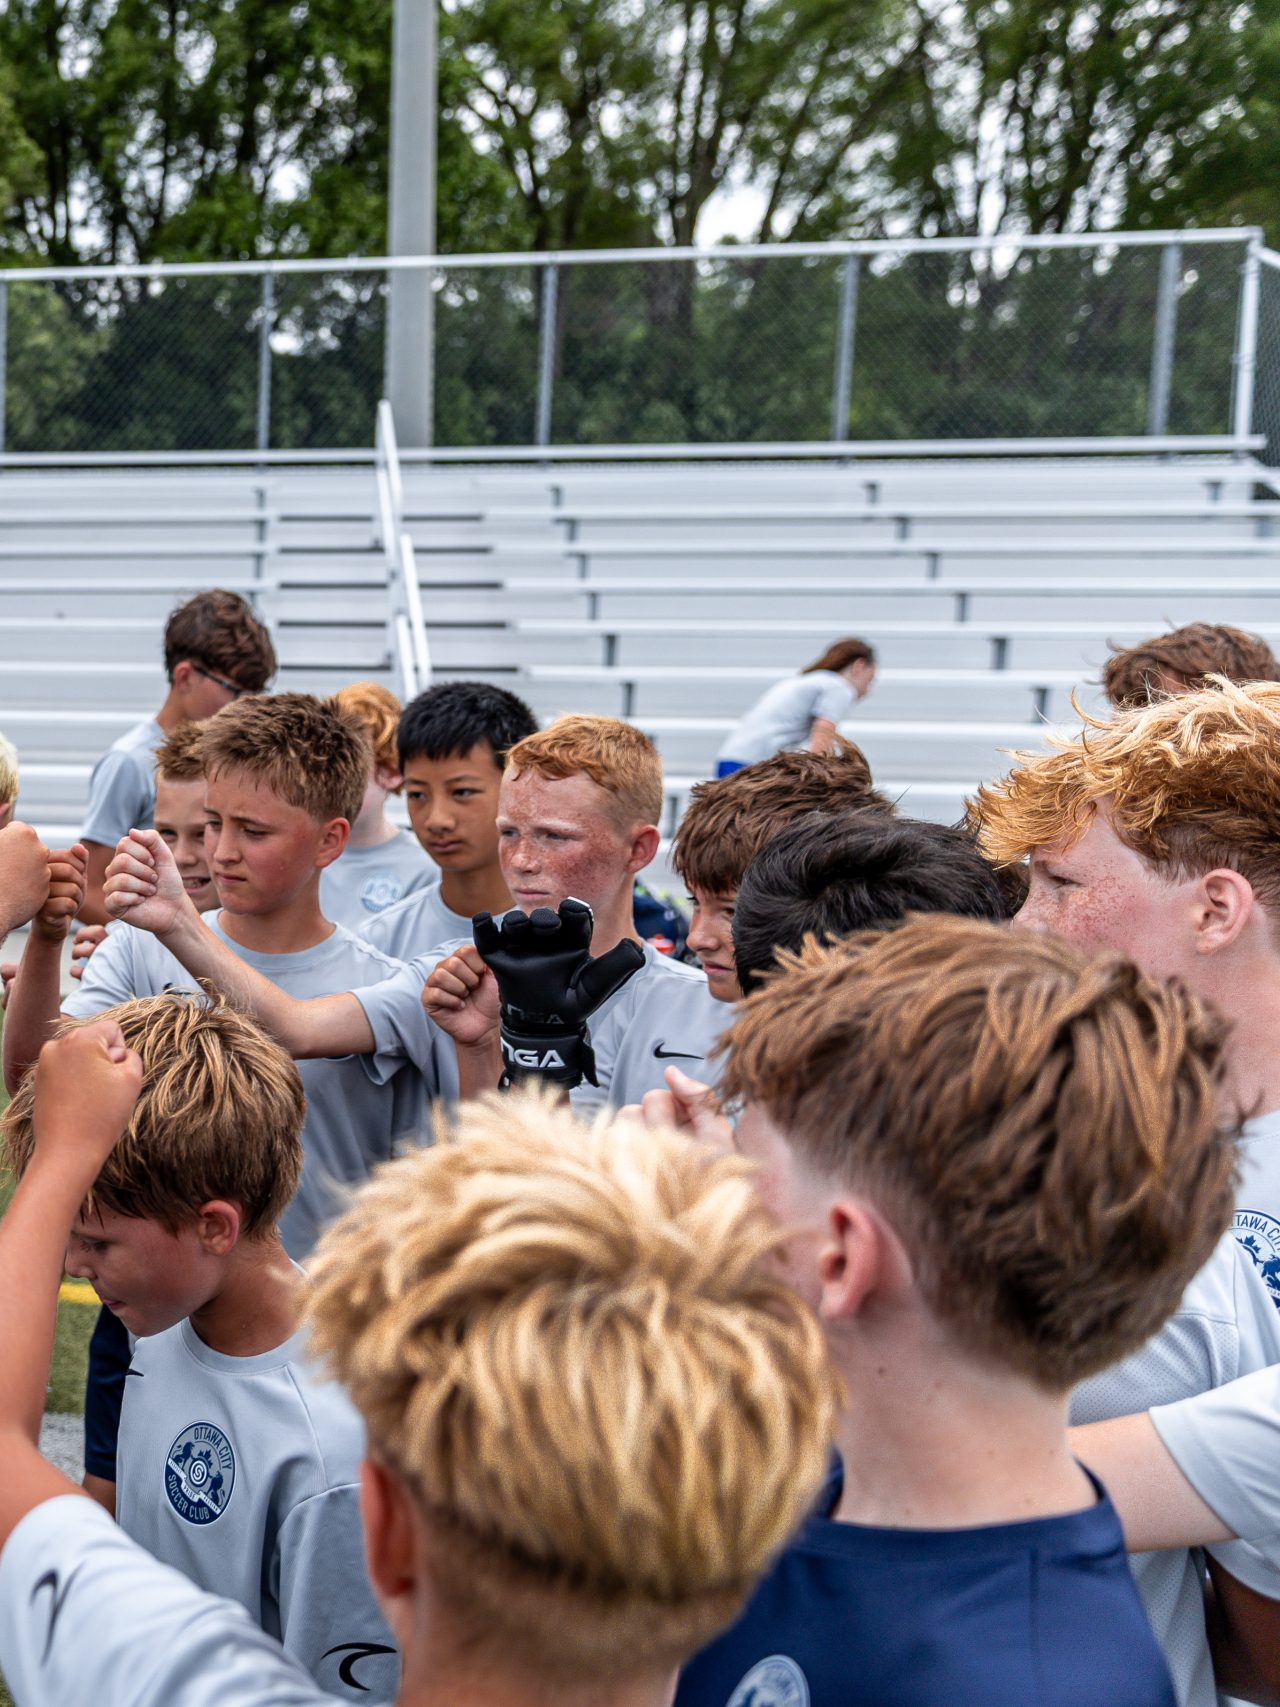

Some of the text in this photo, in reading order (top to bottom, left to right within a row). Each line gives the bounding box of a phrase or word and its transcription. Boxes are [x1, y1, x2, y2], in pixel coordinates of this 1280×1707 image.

[194, 1427, 232, 1470] OTTAWA CITY
[168, 1474, 188, 1514] SOCCER
[189, 1505, 210, 1520] CLUB
